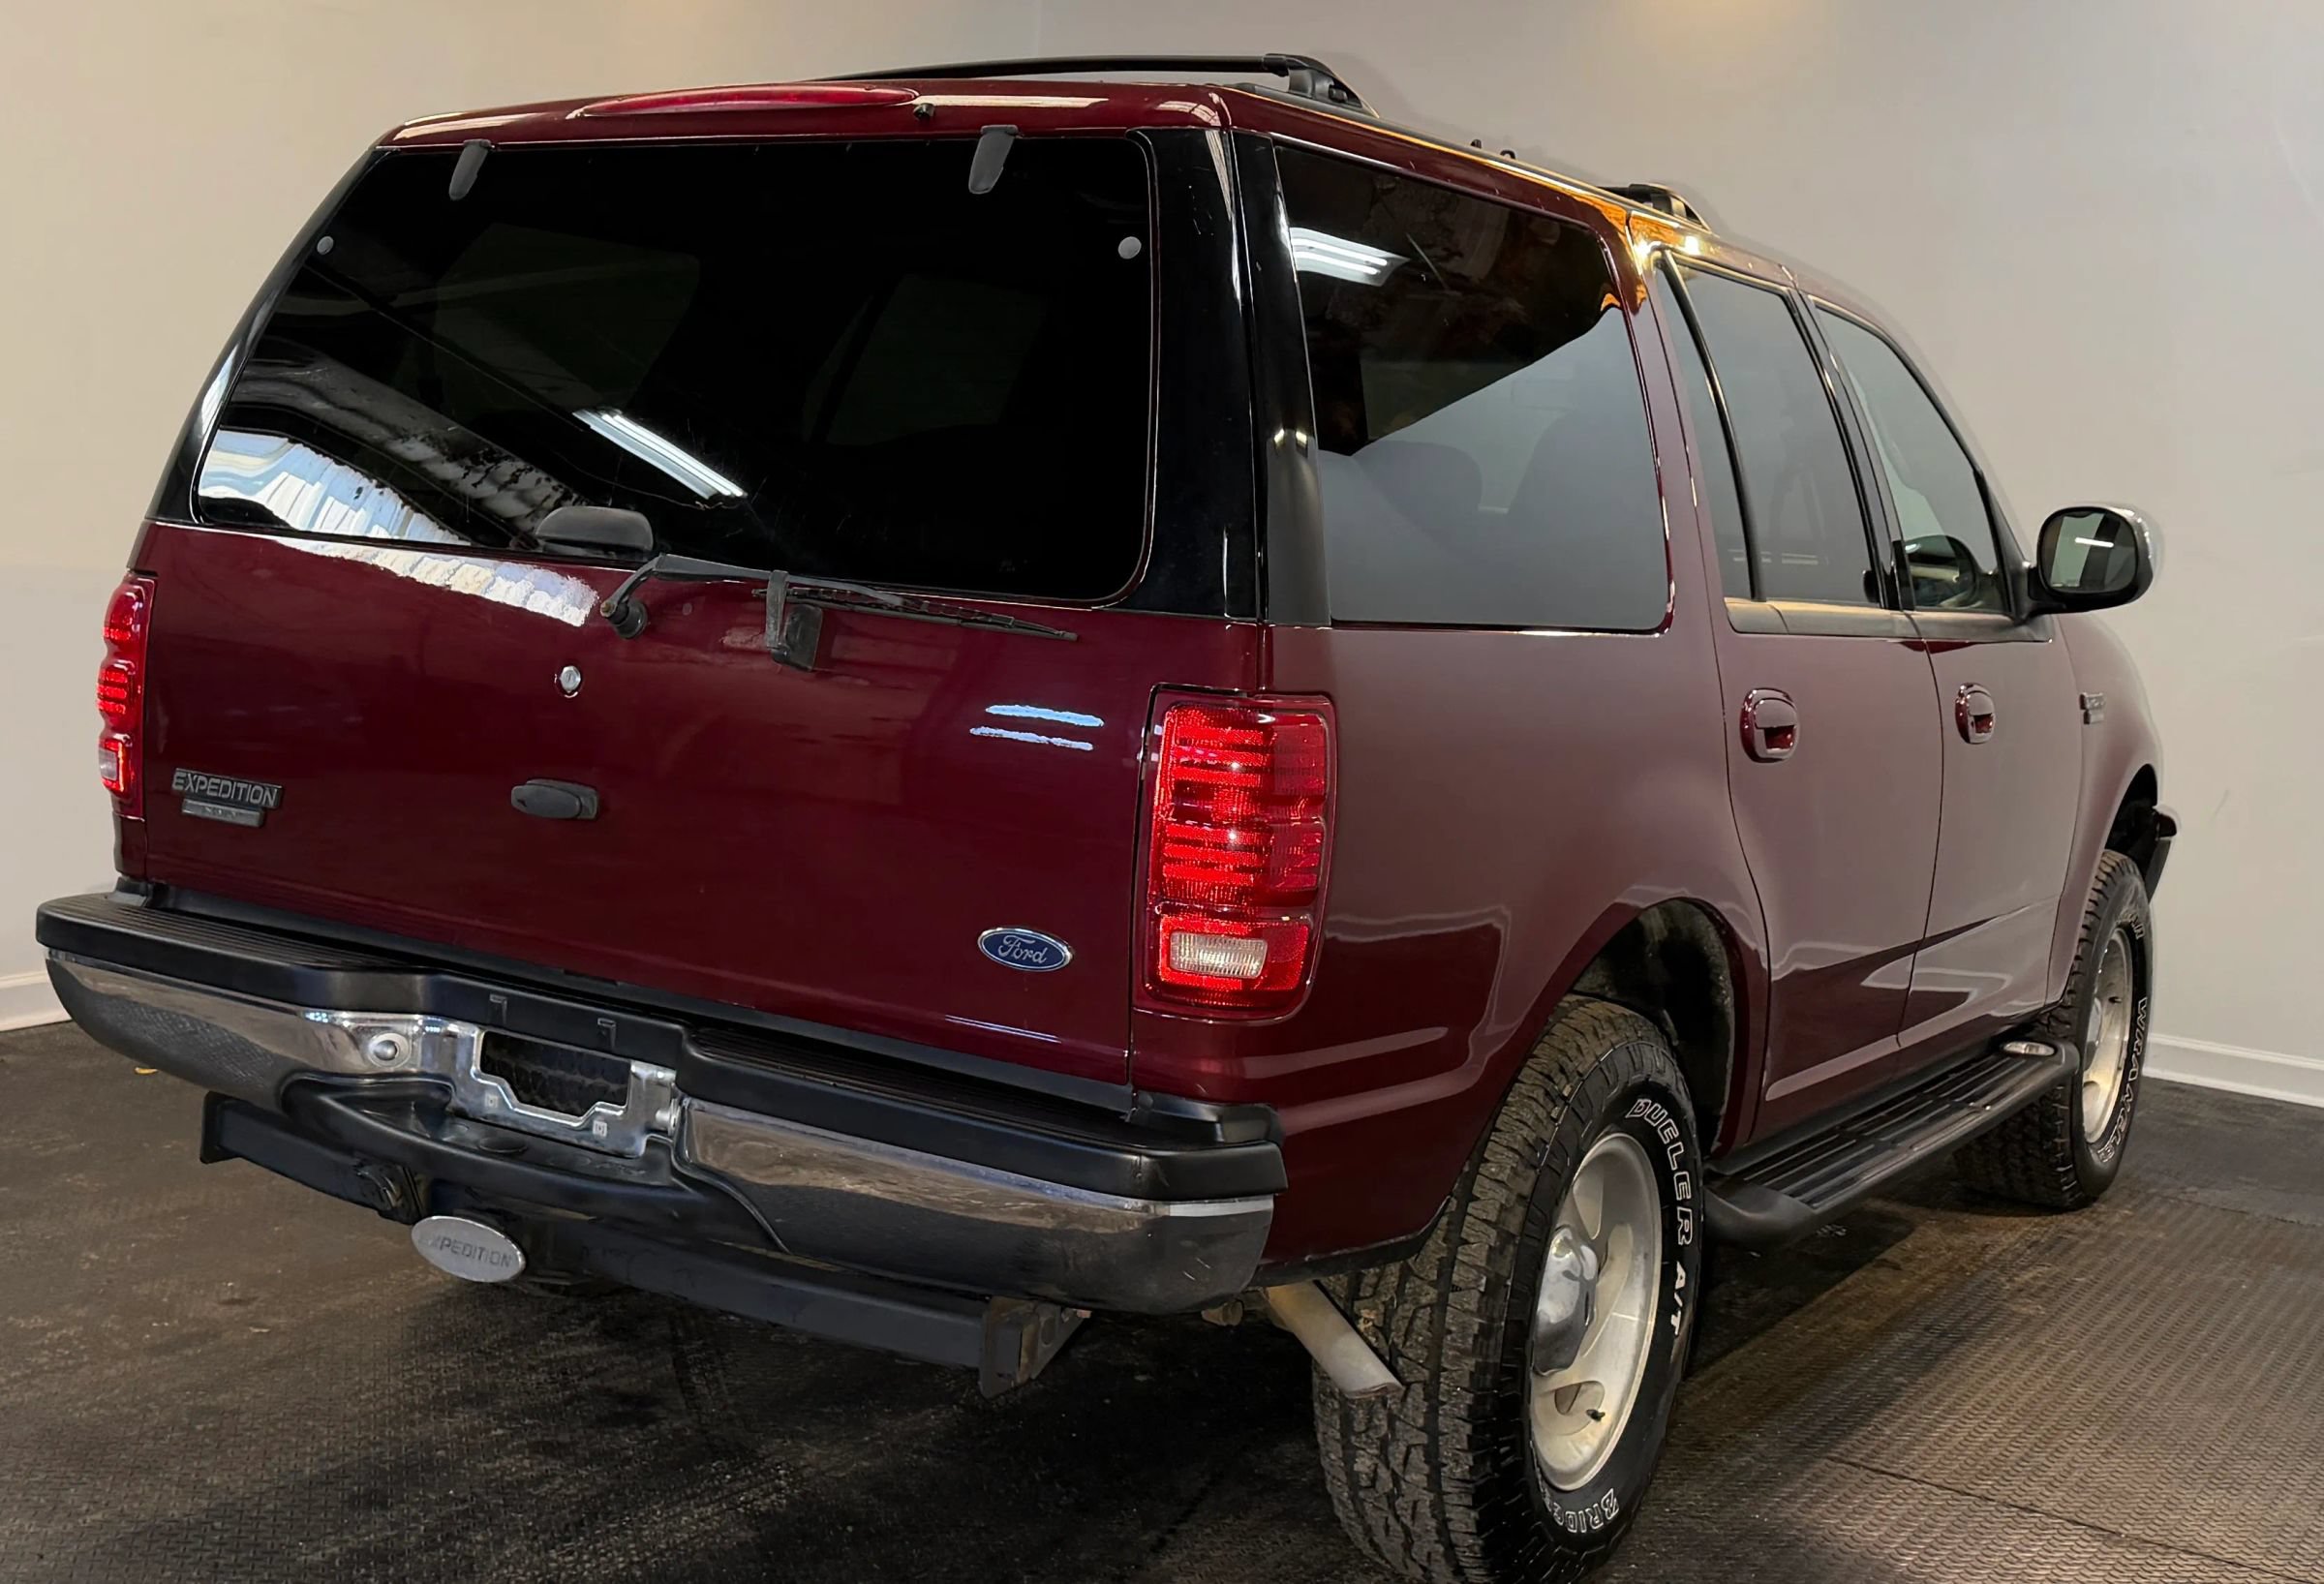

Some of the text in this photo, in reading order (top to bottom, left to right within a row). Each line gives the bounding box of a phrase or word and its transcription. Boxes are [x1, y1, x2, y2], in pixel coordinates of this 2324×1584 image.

[172, 771, 278, 807] EXPEDITION
[998, 934, 1048, 963] Ford
[2097, 997, 2148, 1163] WRANGLE
[1625, 1098, 1693, 1336] DUELER A/T
